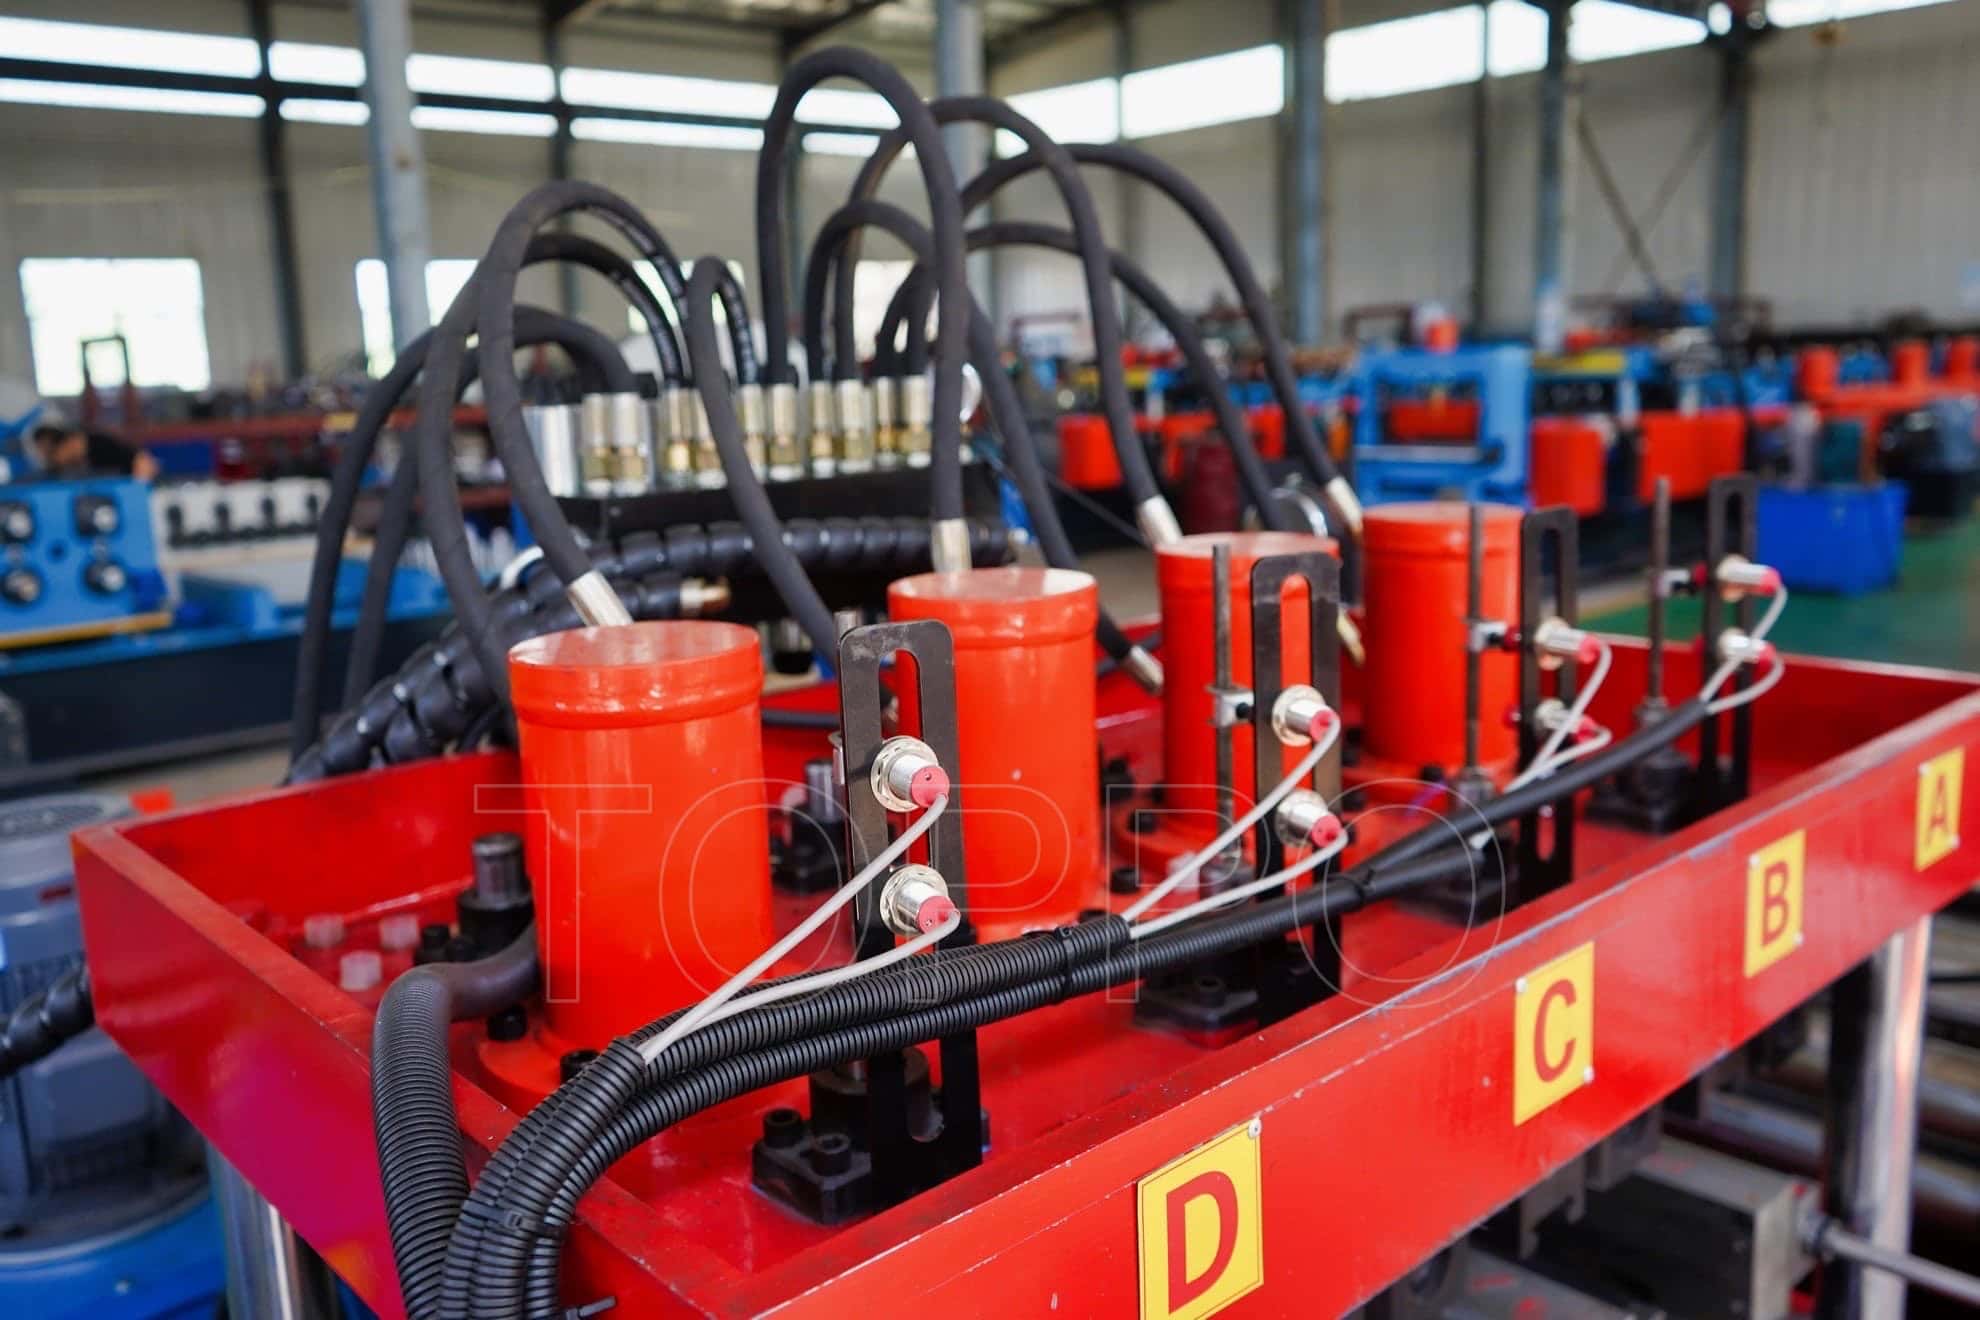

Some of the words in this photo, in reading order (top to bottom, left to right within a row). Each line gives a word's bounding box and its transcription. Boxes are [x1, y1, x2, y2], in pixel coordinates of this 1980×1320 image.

[1925, 773, 1951, 848] A
[1761, 860, 1791, 946] B
[1533, 977, 1578, 1083] C
[1167, 1171, 1240, 1315] D
